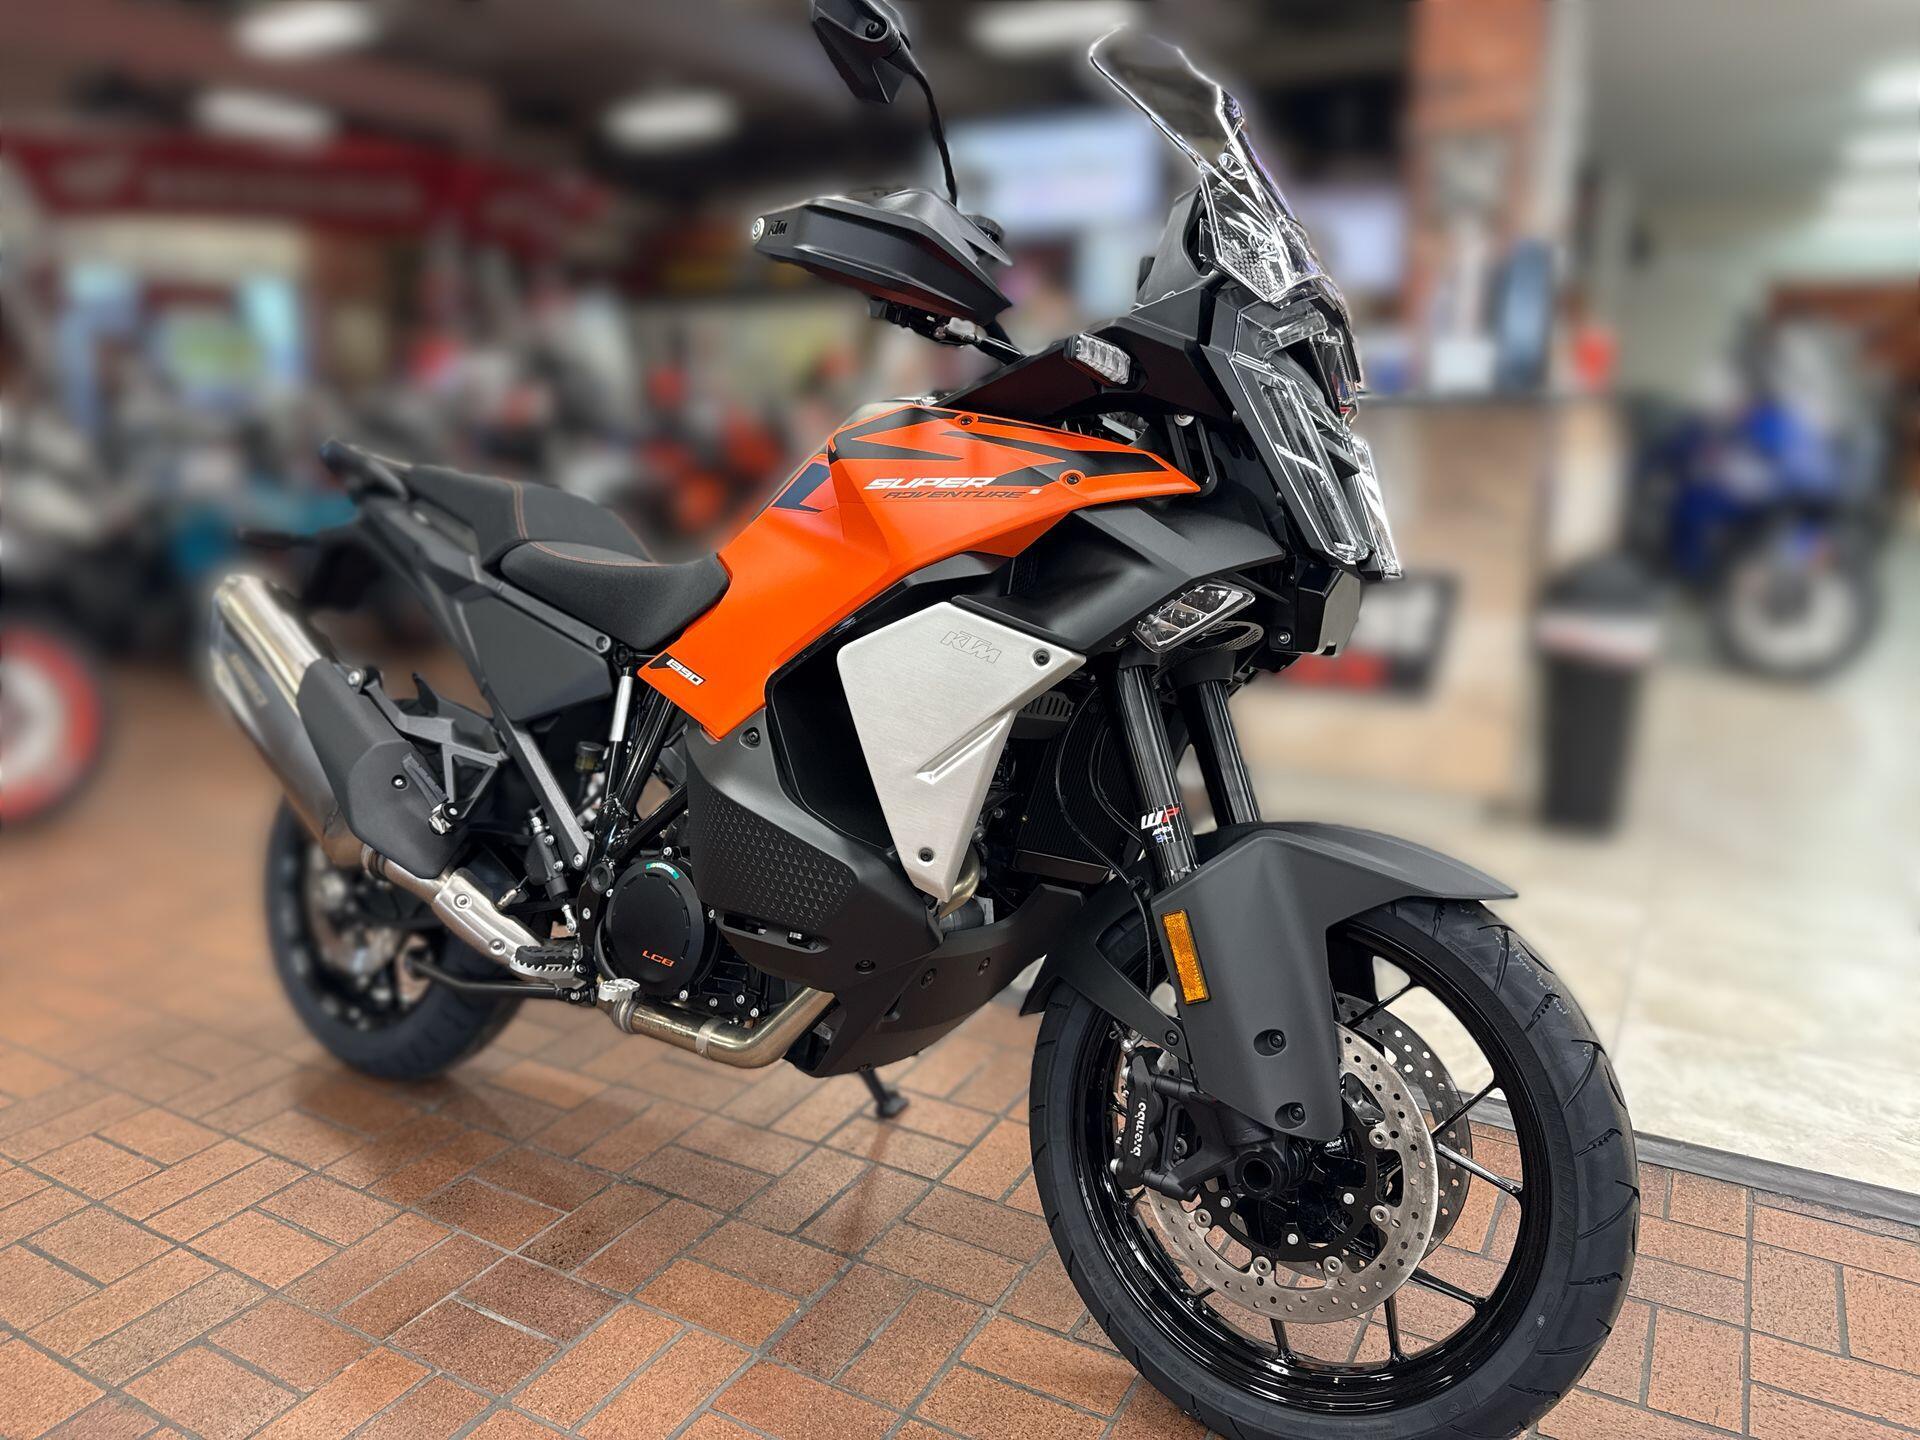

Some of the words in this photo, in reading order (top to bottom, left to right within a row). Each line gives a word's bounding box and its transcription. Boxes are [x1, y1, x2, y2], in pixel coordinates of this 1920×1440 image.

[768, 220, 787, 235] KTM
[863, 477, 996, 490] SUPER
[883, 491, 1026, 499] ADVENTURE
[940, 630, 1001, 664] KTM
[1141, 807, 1179, 829] WP
[1130, 1102, 1147, 1157] brembo
